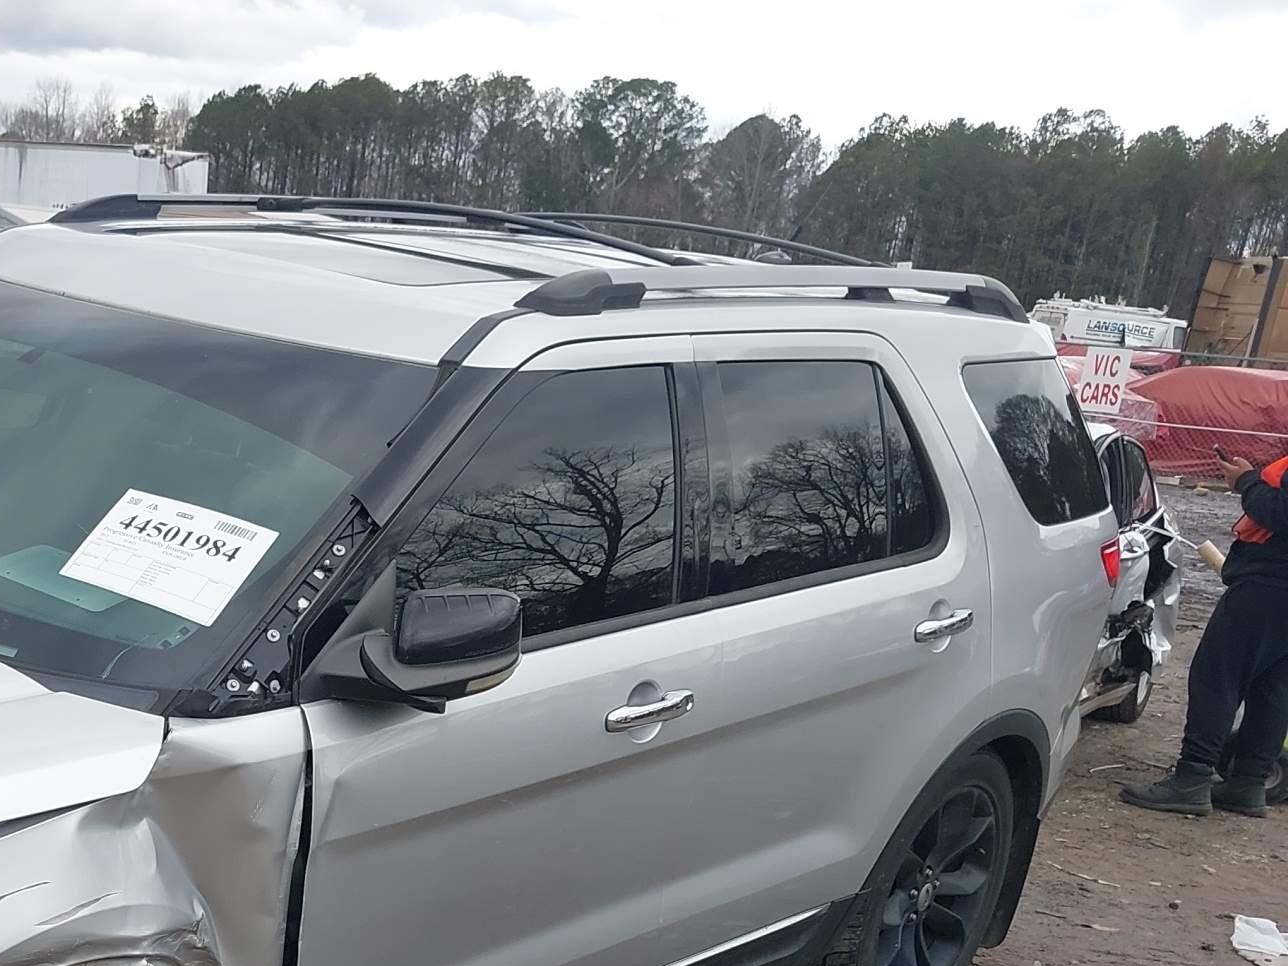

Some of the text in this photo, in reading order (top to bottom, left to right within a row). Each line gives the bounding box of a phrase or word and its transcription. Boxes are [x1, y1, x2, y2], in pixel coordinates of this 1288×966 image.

[1086, 320, 1156, 337] LANSOURCE
[1094, 354, 1121, 378] VIC
[1080, 382, 1121, 406] CARS
[120, 514, 242, 563] 44501984
